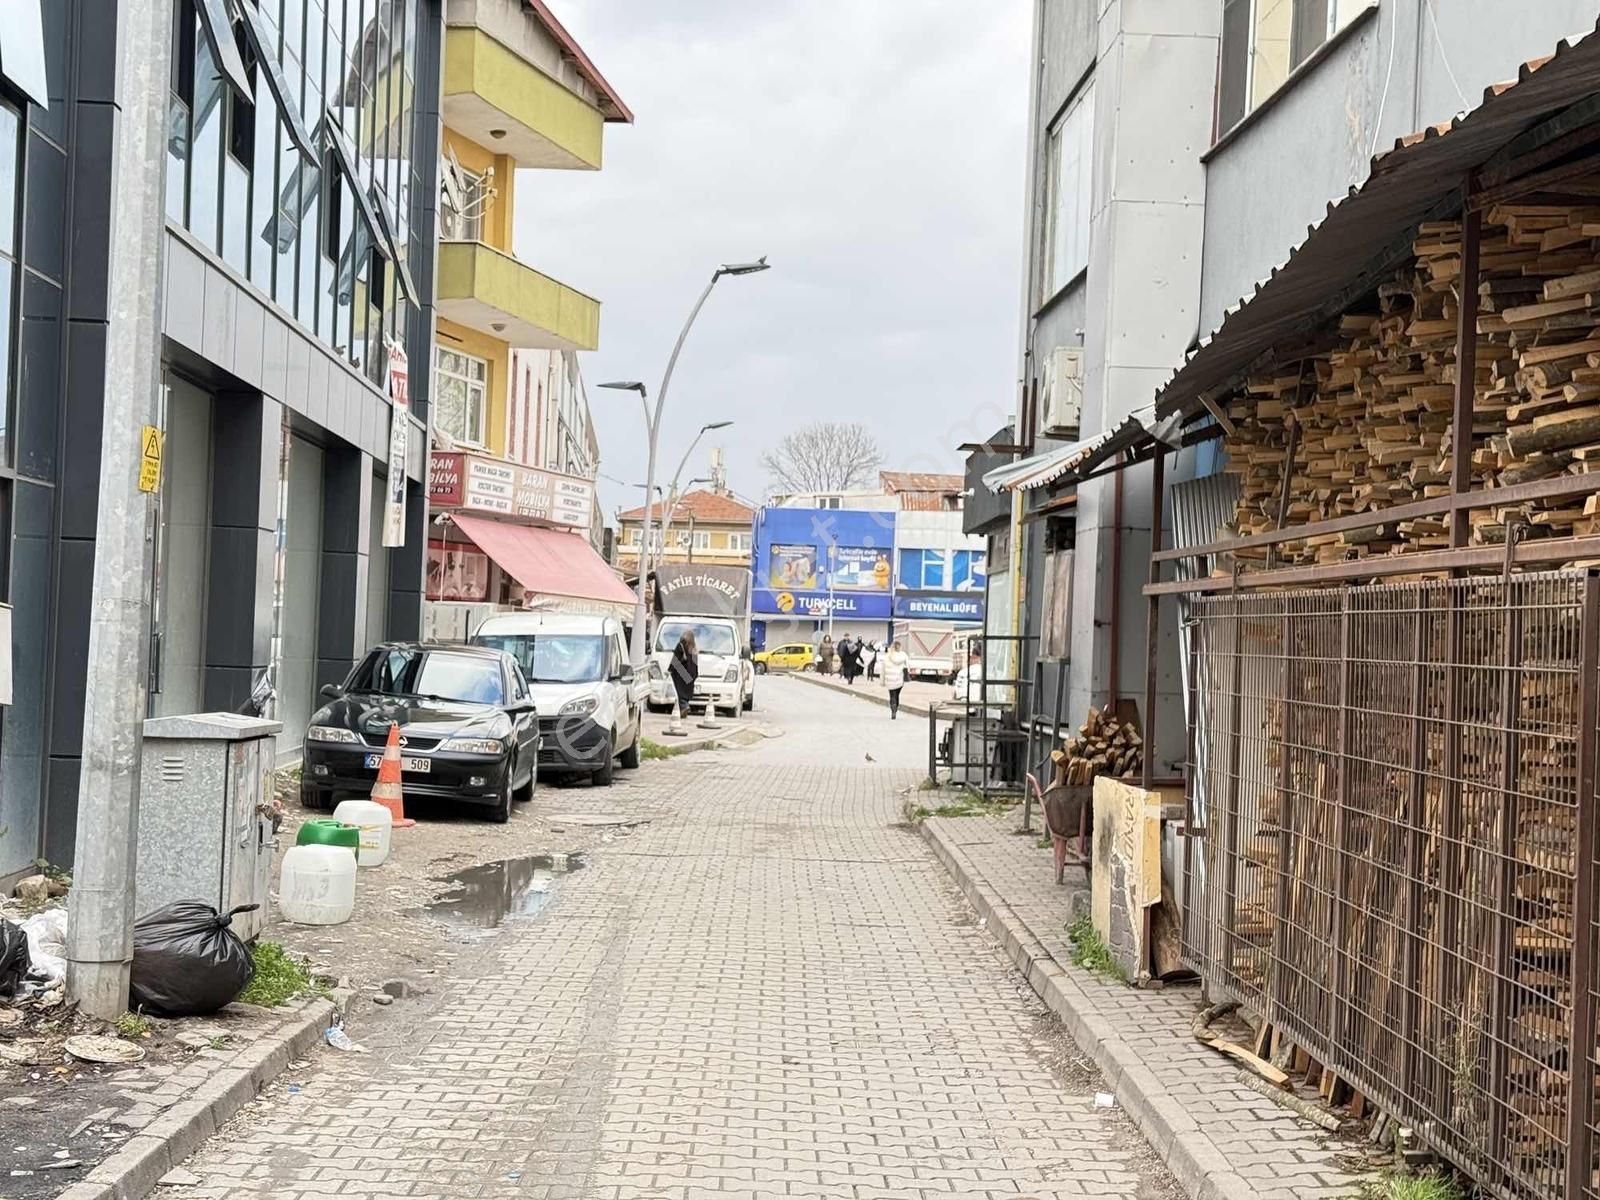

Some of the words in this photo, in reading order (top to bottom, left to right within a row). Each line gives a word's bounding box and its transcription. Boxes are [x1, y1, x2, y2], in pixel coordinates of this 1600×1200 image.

[521, 472, 548, 489] BARAN
[660, 574, 694, 595] FATİH
[696, 573, 741, 599] TİCARET
[799, 597, 857, 611] TURKCELL
[910, 602, 952, 613] BEYENAL
[952, 602, 977, 613] BÜFE
[410, 758, 430, 770] 509
